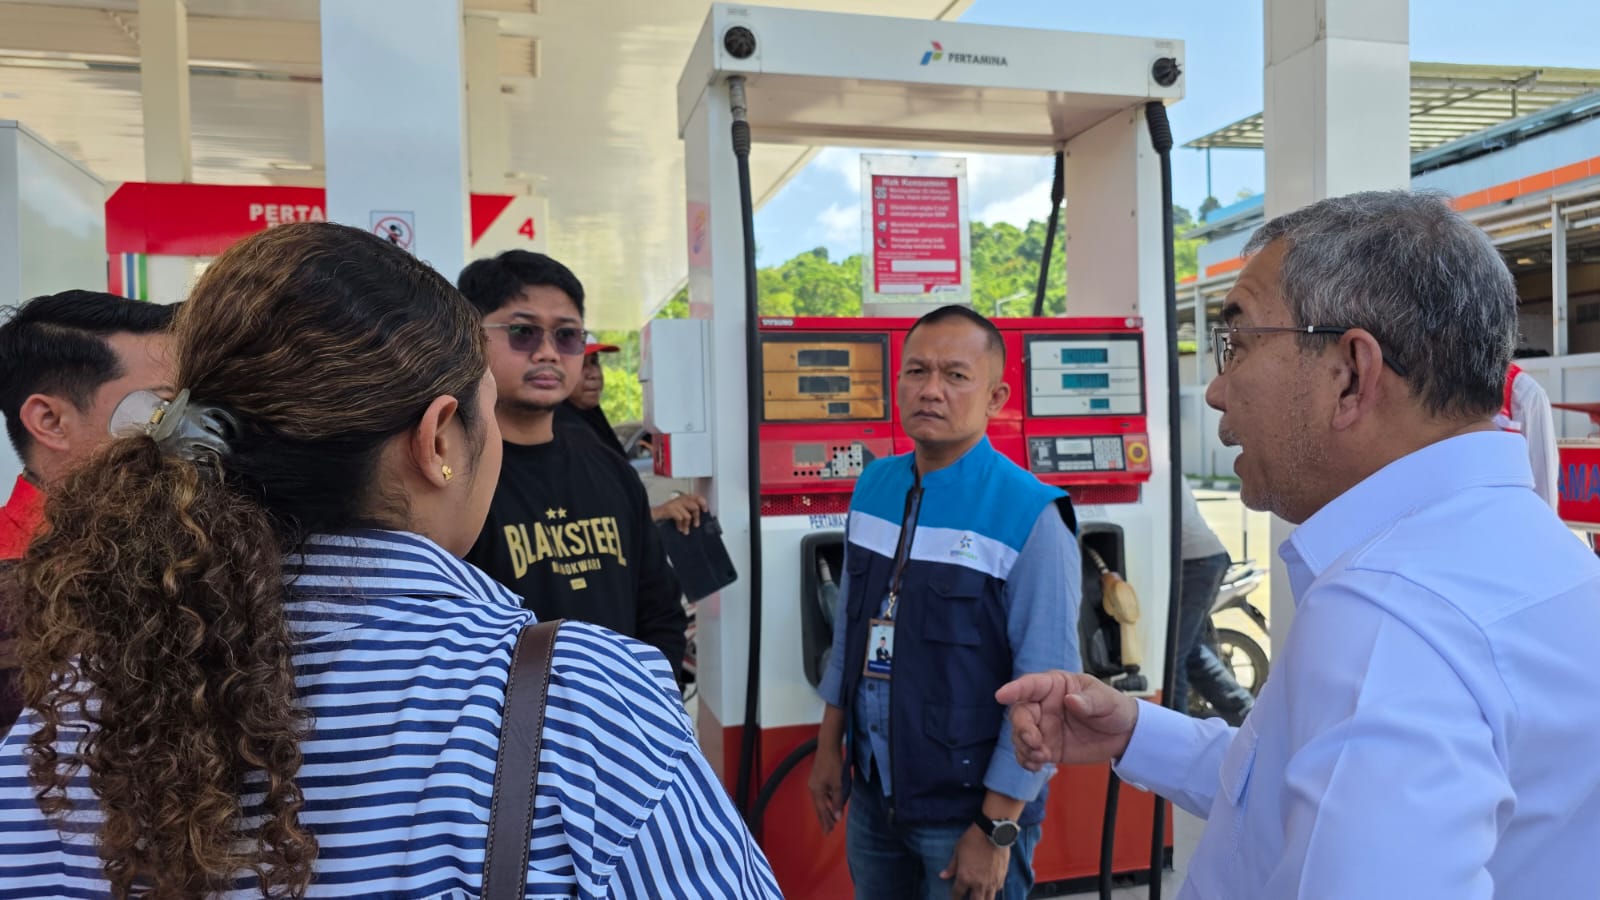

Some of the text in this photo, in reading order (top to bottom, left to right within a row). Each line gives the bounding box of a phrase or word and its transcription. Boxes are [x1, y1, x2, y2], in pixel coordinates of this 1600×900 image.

[948, 52, 1008, 66] PERTAMINA
[249, 203, 325, 223] PERTA
[518, 216, 535, 240] 4
[503, 516, 627, 579] BLAKSTEEL
